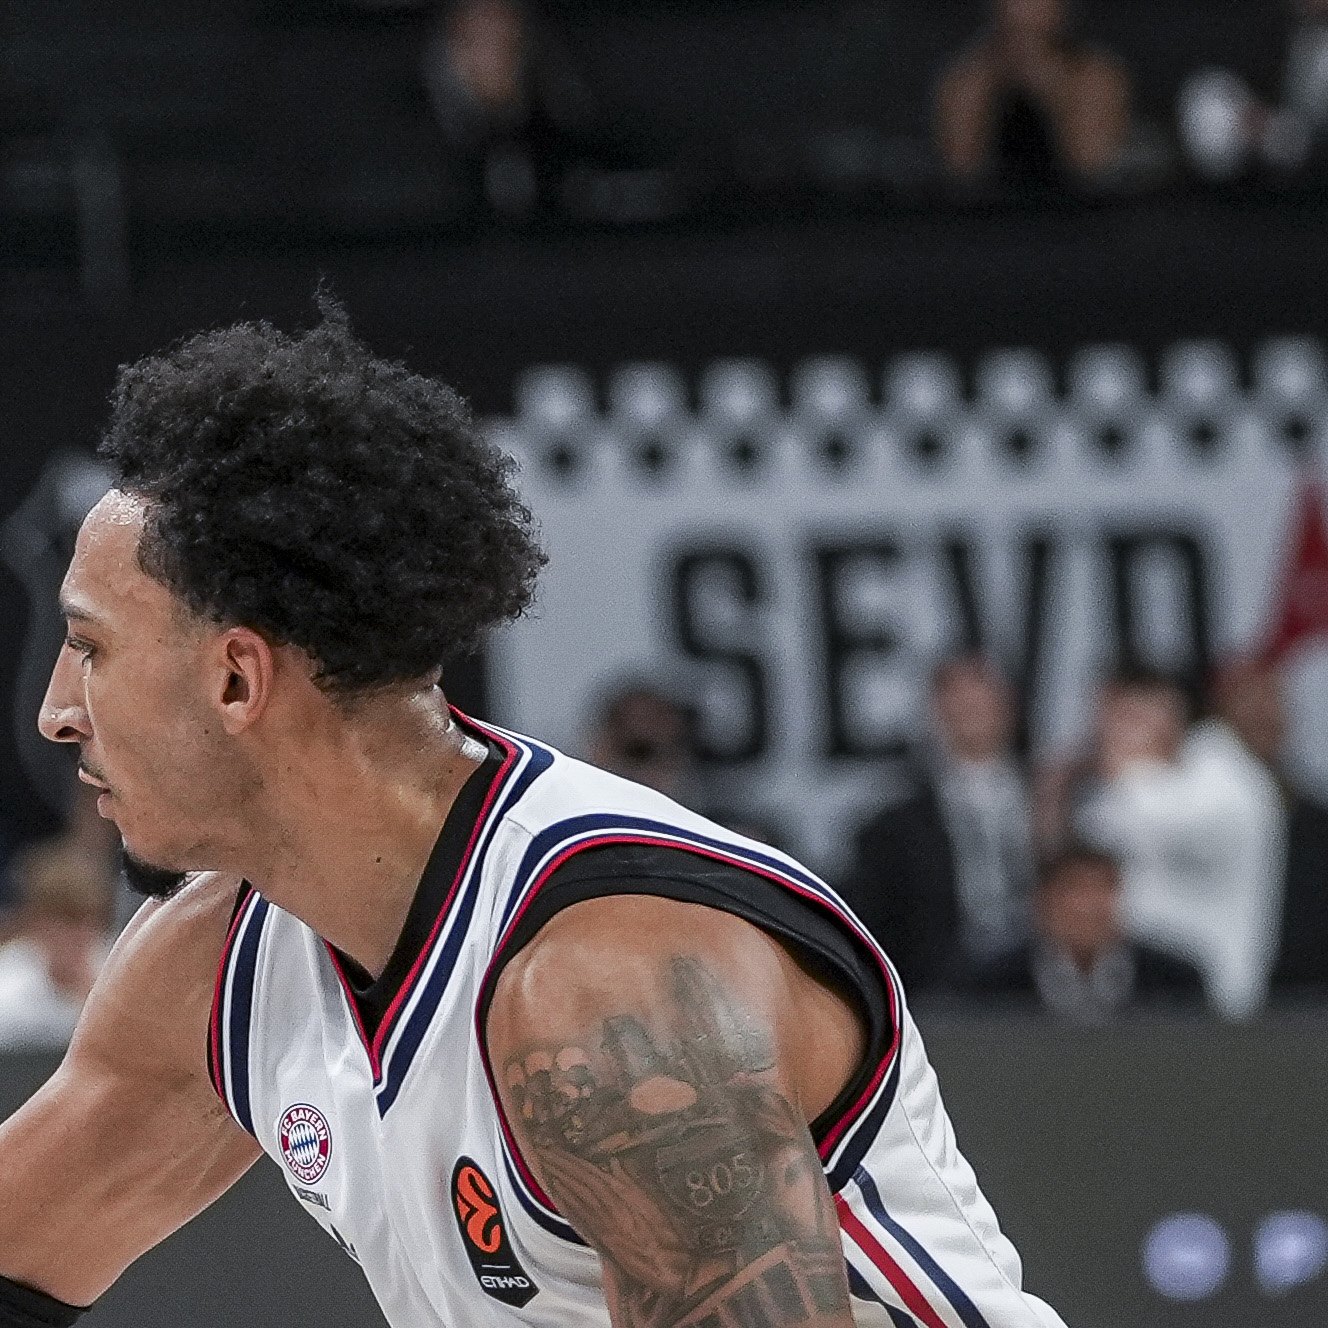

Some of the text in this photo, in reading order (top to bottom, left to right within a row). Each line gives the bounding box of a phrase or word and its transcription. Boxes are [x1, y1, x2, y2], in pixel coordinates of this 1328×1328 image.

[282, 1109, 328, 1141] FC BAYERN
[480, 1275, 530, 1289] ETIHAD
